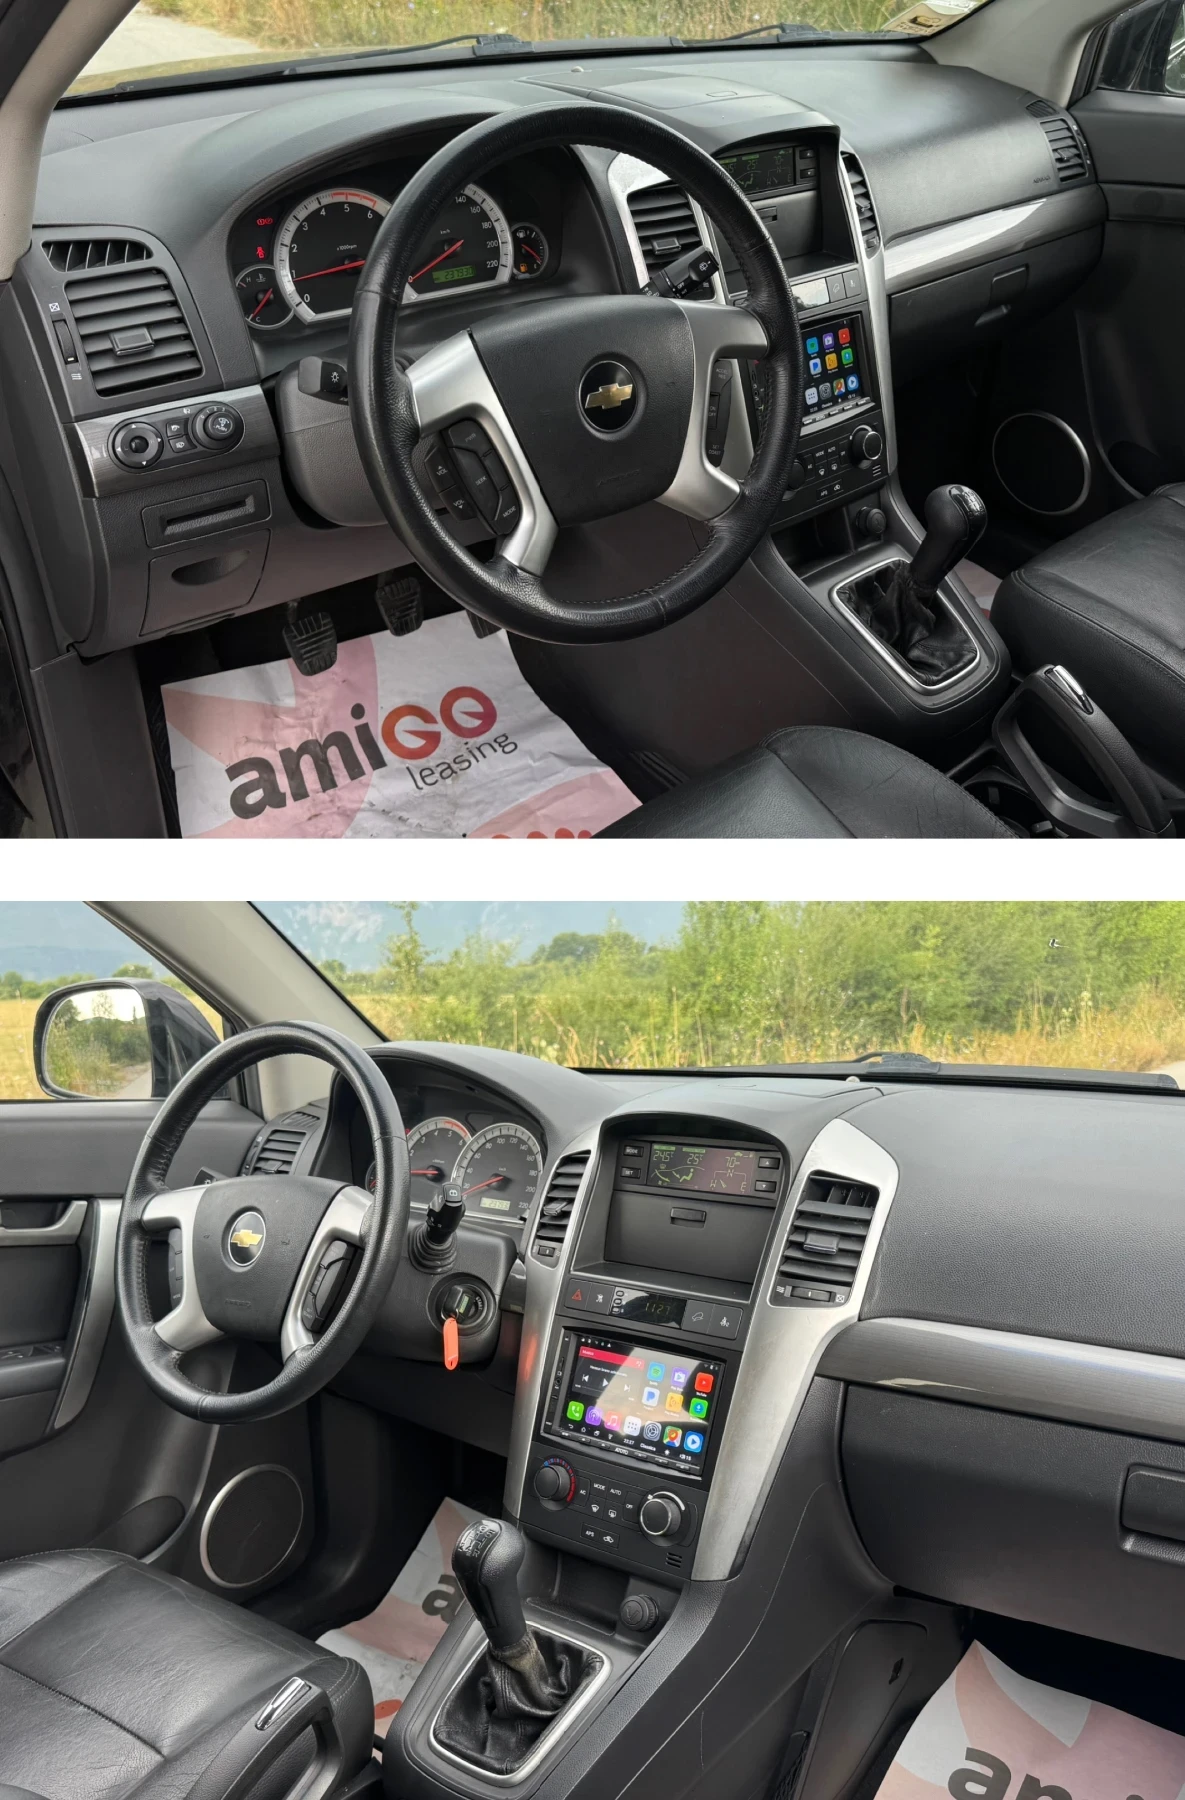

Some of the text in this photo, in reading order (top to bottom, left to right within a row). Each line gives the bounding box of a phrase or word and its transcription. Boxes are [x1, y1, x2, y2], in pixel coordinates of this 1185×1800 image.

[320, 208, 326, 216] 4
[344, 204, 350, 212] 5
[367, 210, 373, 219] 6
[302, 222, 308, 231] 3
[291, 244, 298, 252] 2
[486, 260, 498, 268] 220
[303, 293, 310, 302] 0
[502, 505, 516, 517] MODE
[225, 686, 497, 819] amiGO
[405, 733, 518, 790] leasing
[593, 1482, 606, 1491] MODE
[610, 1488, 622, 1496] AUTO
